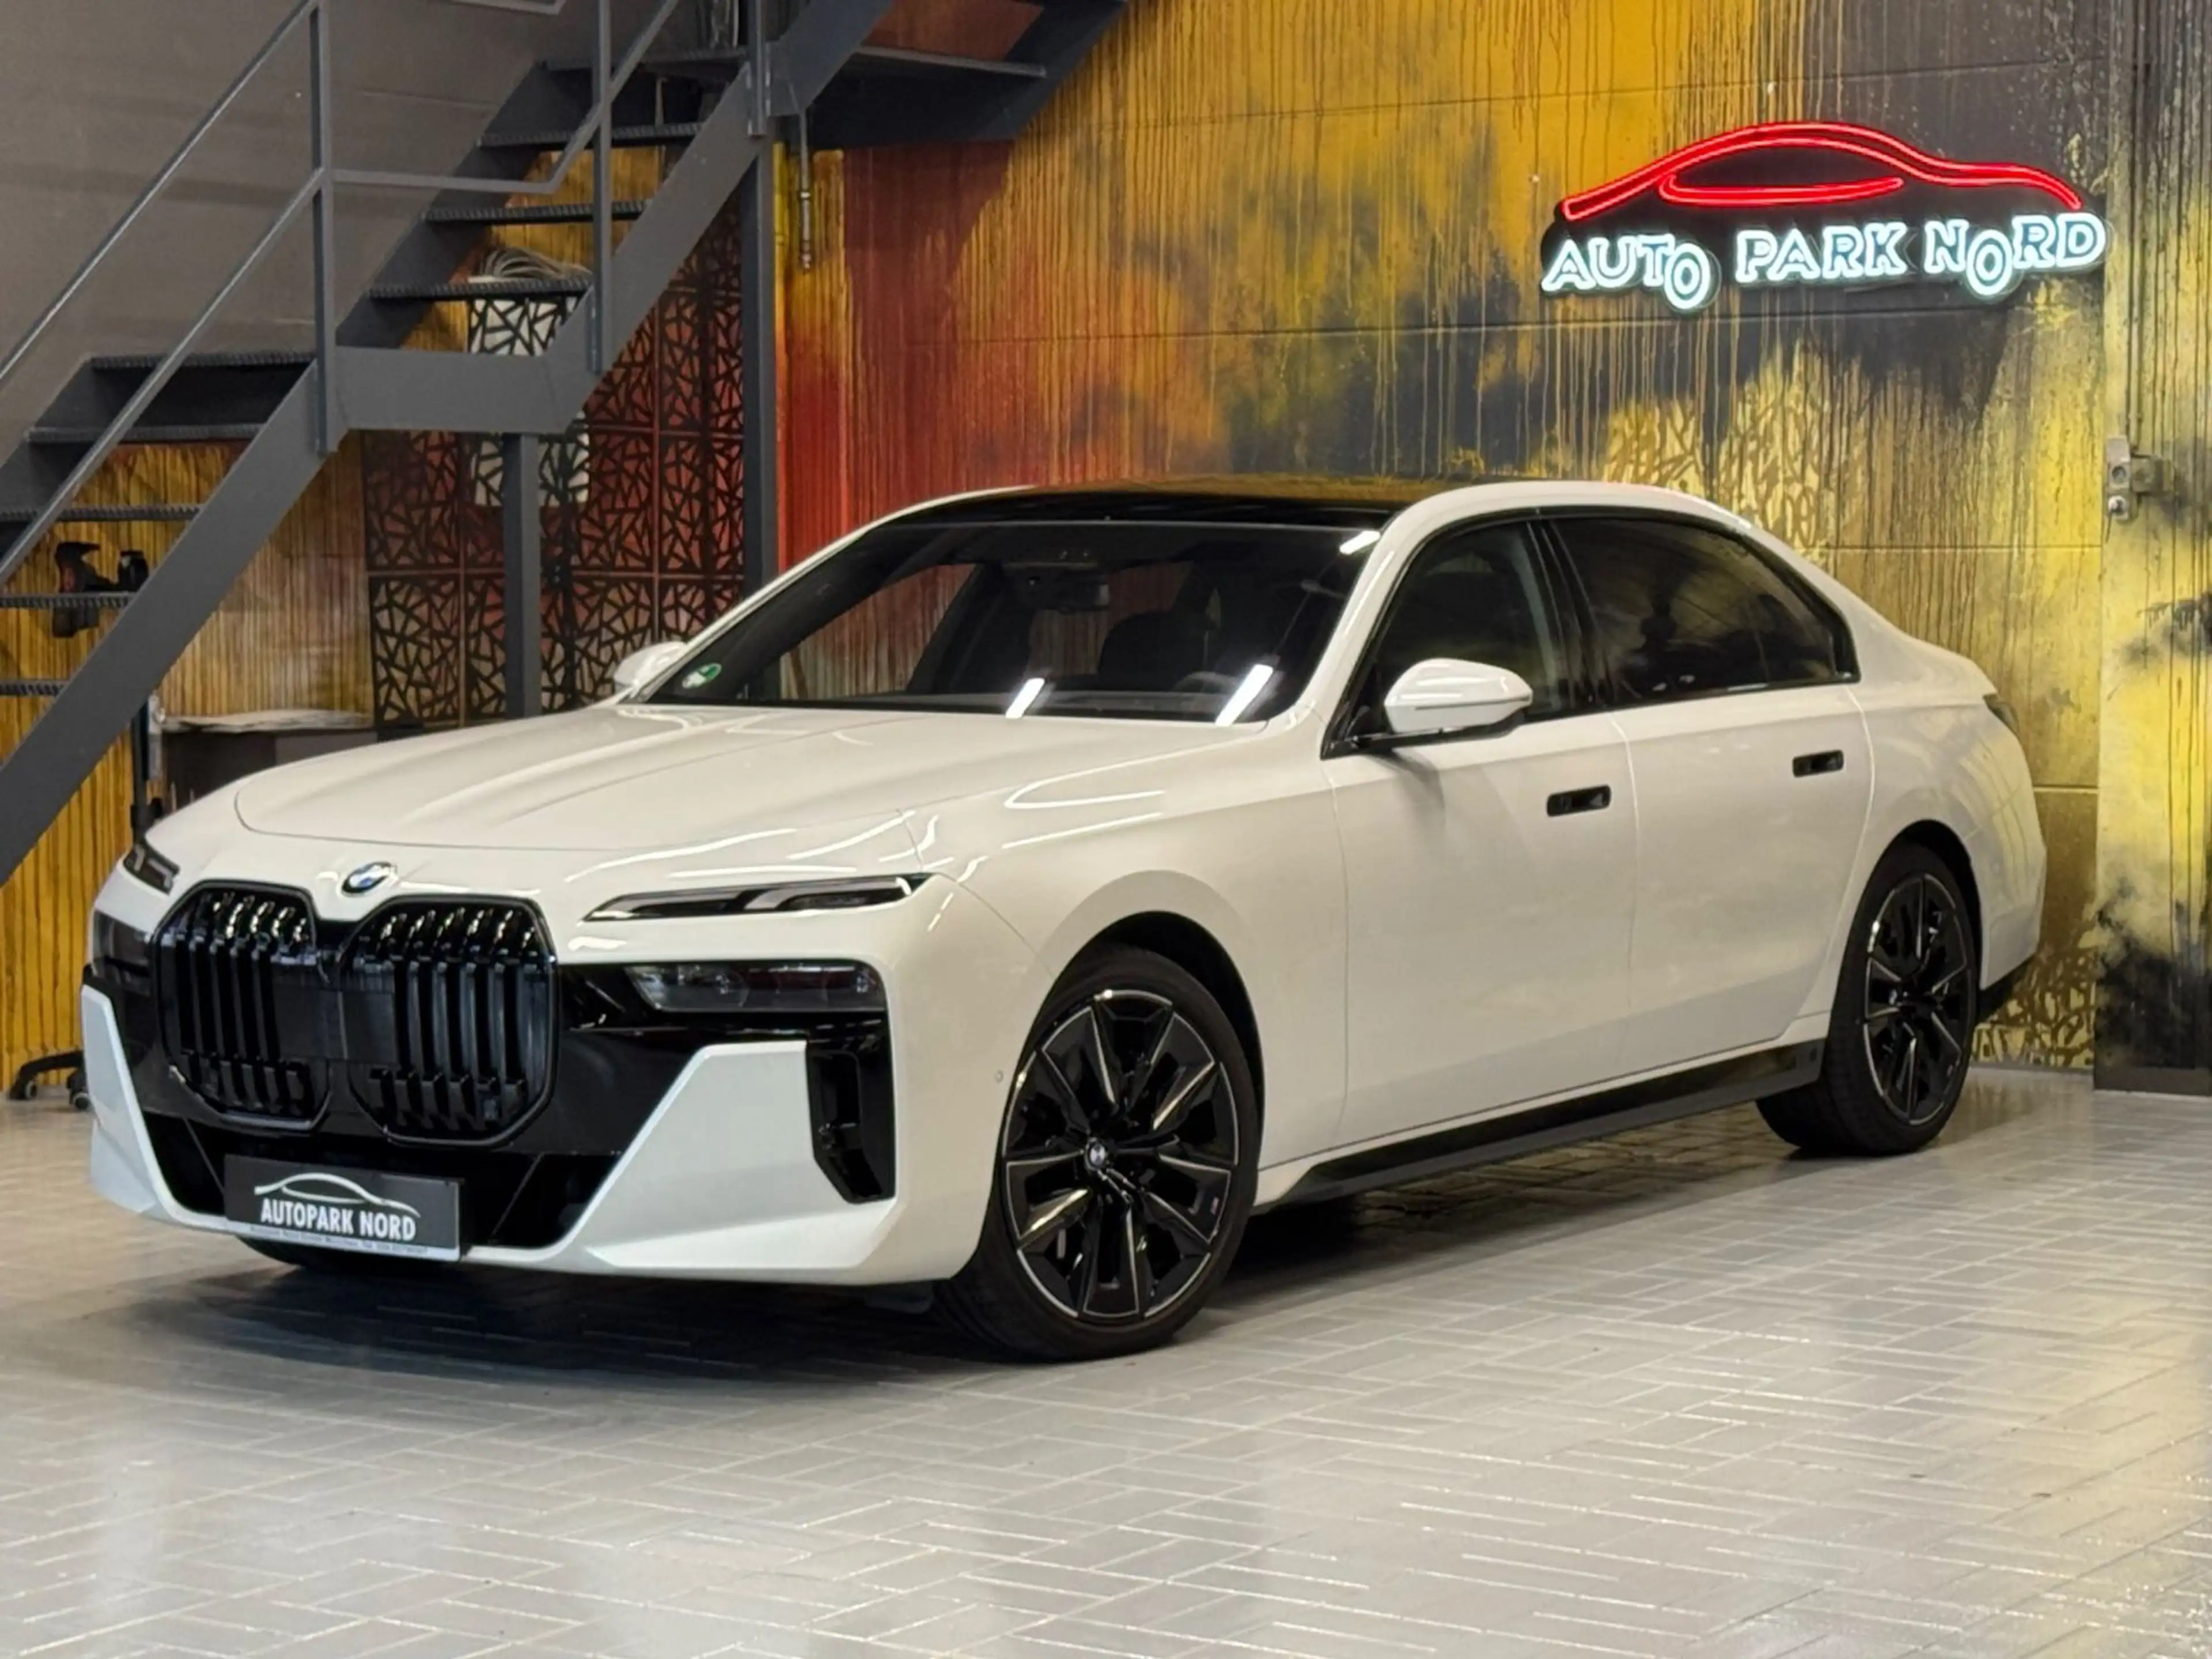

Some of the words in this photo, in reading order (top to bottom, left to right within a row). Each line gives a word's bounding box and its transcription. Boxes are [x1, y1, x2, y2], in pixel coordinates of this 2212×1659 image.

[1541, 233, 1712, 310] AUTO
[1734, 221, 1908, 283] PARK
[1924, 211, 2107, 297] NORD
[260, 1198, 354, 1234] AUTOPARK
[359, 1212, 416, 1241] NORD
